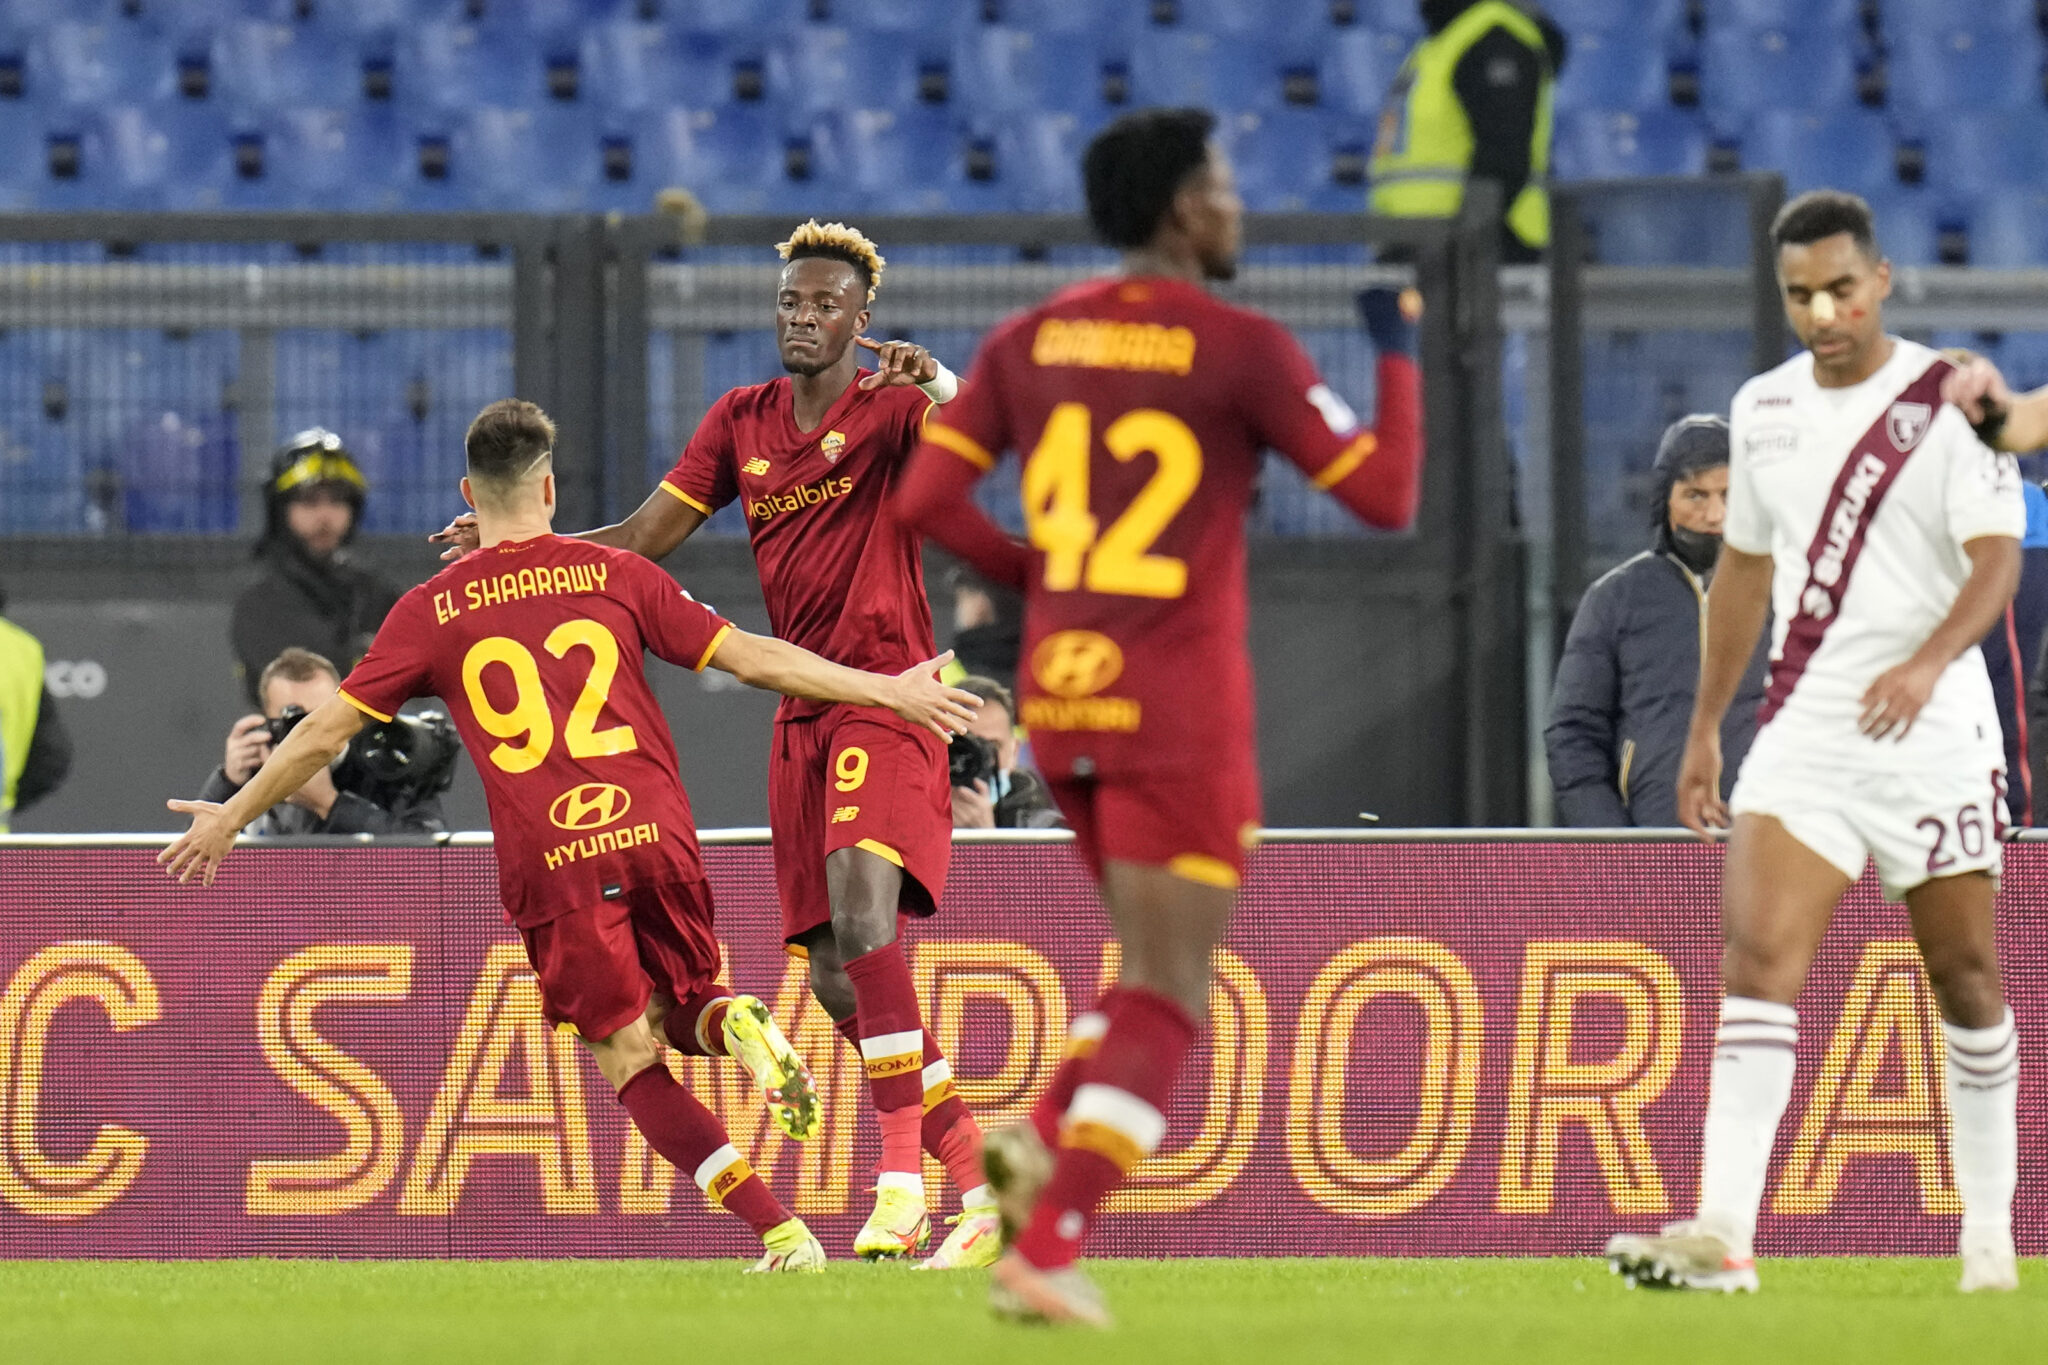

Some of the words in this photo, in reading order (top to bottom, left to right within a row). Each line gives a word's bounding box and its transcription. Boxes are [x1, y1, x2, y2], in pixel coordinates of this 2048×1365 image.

[1021, 401, 1204, 598] 42
[1812, 452, 1888, 588] SUZUKI
[433, 589, 460, 625] EL
[464, 562, 608, 611] SHAARAWY
[462, 619, 638, 774] 92
[834, 746, 869, 792] 9
[543, 822, 660, 871] HYUNDAI
[1915, 803, 1983, 873] 26
[245, 936, 1964, 1218] SAMPDORA
[868, 1054, 923, 1074] ROMA
